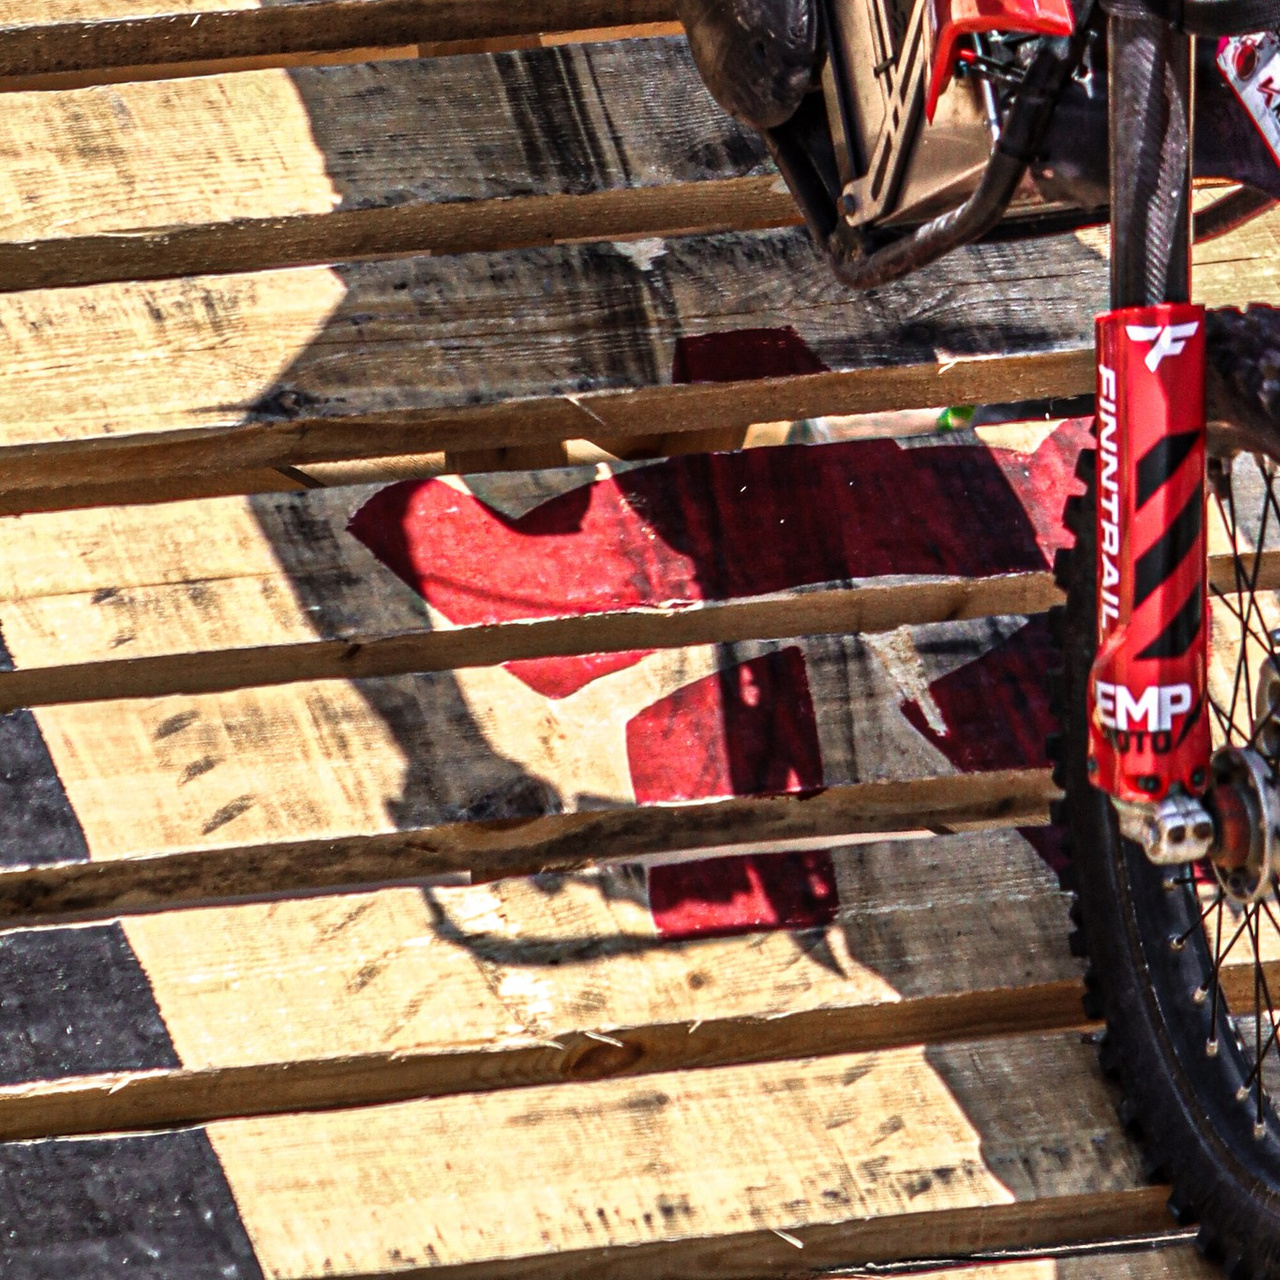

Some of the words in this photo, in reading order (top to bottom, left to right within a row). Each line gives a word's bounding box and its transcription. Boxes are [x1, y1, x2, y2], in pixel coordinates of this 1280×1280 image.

[1098, 363, 1121, 634] FINNTRAIL
[1095, 680, 1192, 733] EMP
[1107, 730, 1172, 755] OTO
